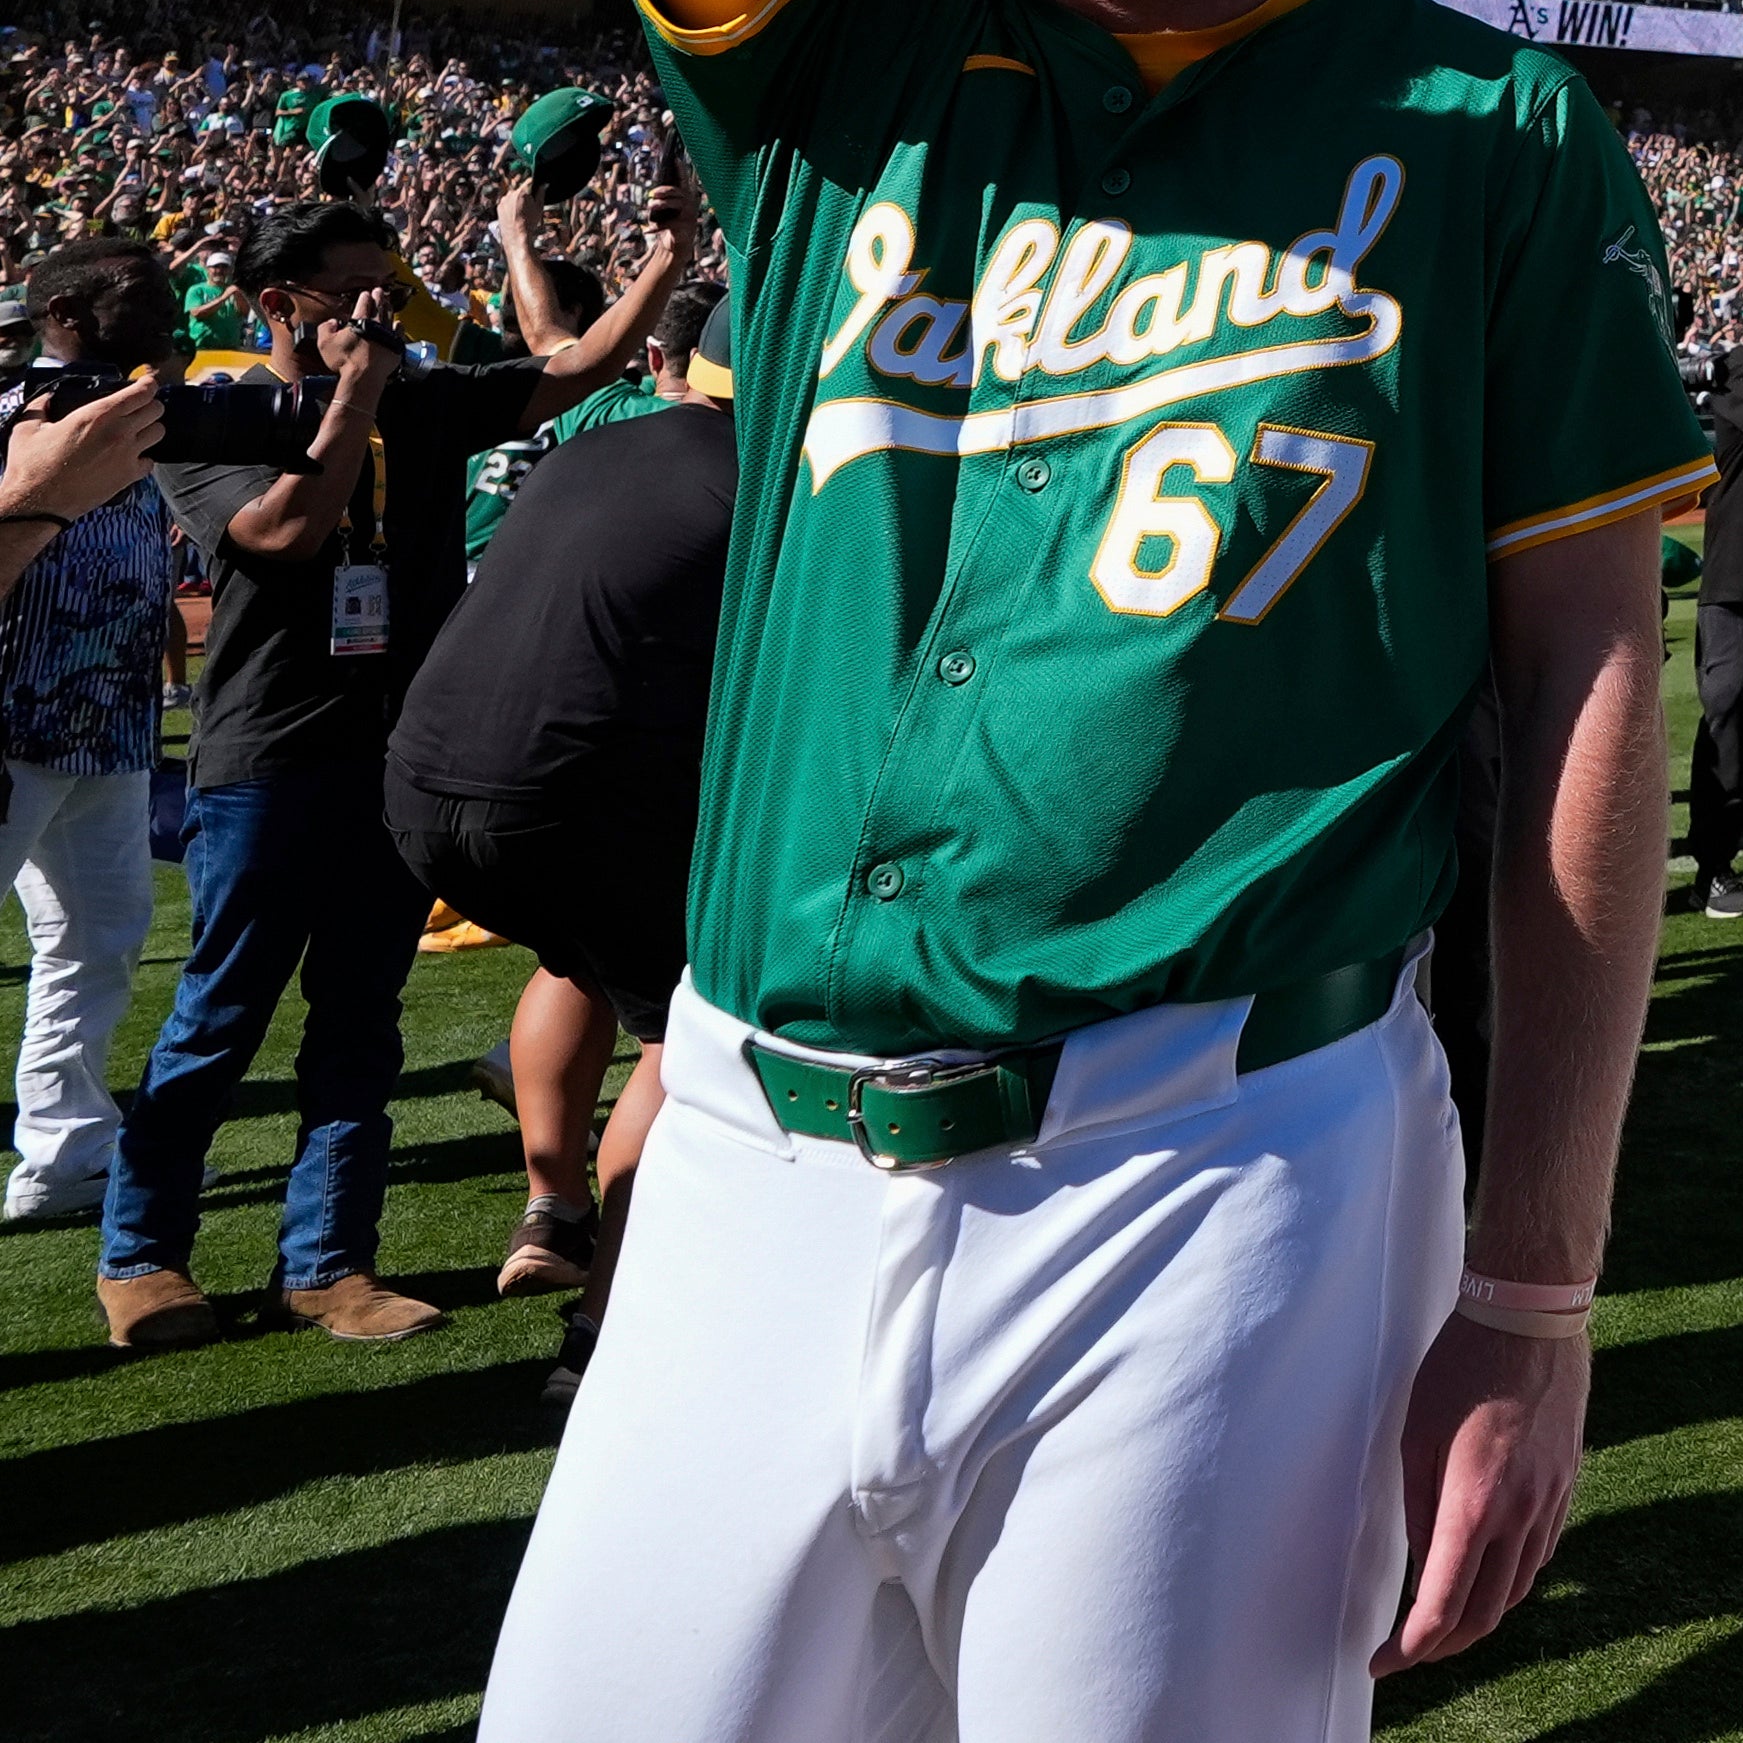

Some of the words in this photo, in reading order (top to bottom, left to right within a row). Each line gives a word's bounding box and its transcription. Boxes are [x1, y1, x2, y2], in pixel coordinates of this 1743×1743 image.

[1556, 0, 1635, 48] WIN!
[817, 152, 1403, 390] Oakland
[1087, 421, 1377, 626] 67
